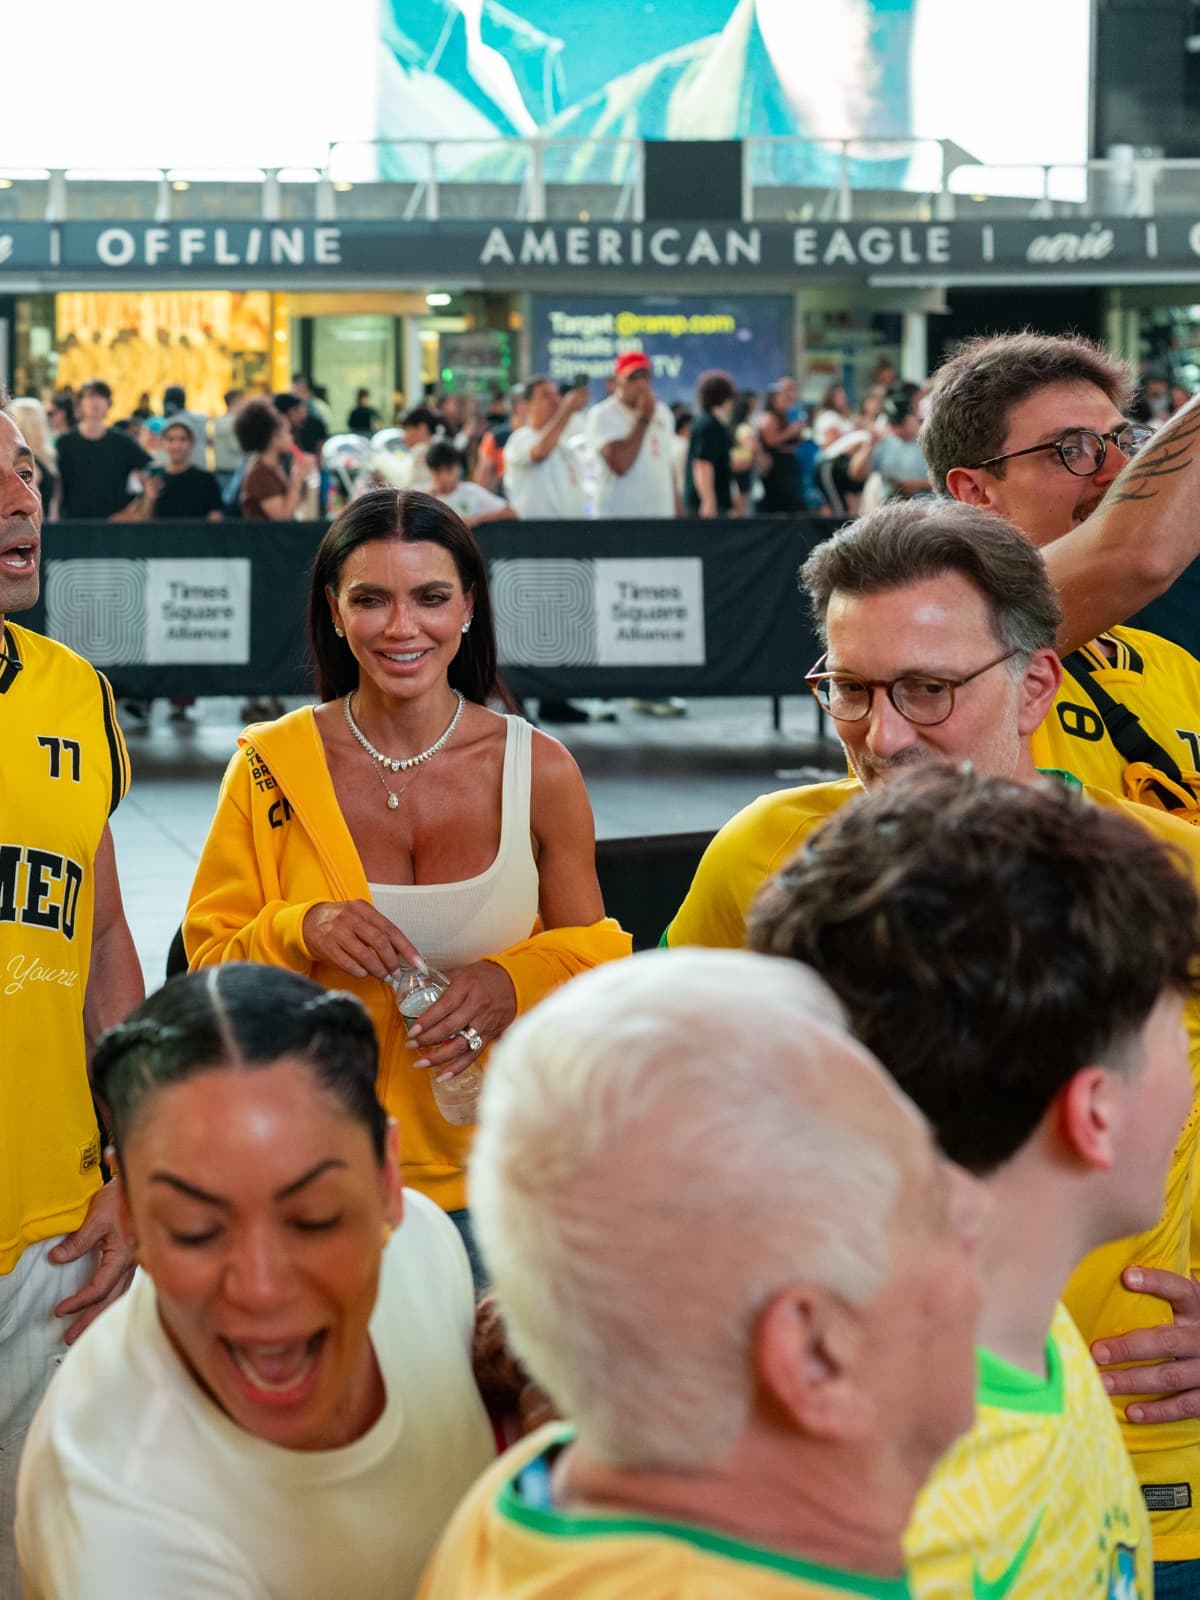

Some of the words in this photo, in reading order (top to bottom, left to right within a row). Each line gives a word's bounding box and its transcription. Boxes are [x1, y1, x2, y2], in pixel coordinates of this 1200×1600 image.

[96, 228, 343, 267] OFFLINE
[479, 227, 762, 267] AMERICAN
[793, 226, 951, 266] EAGLE
[549, 311, 614, 340] Target
[167, 581, 229, 600] Times
[616, 581, 682, 600] Times
[36, 734, 81, 784] 77
